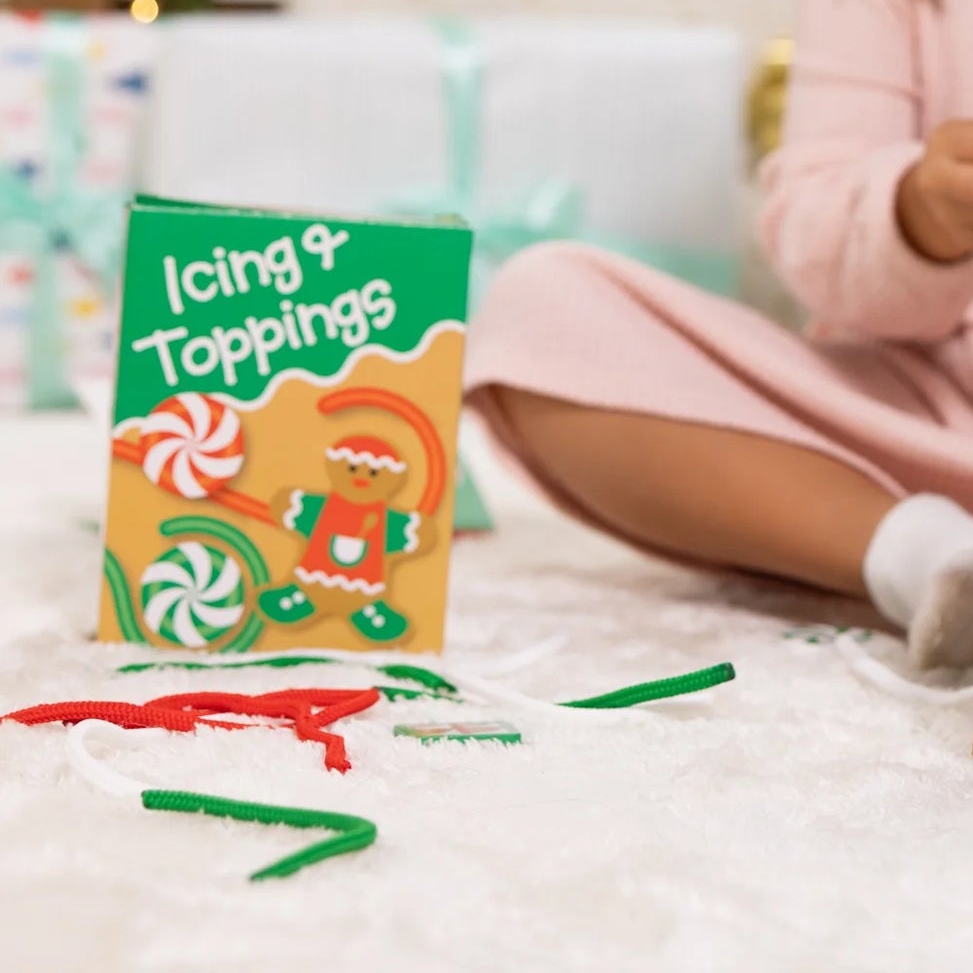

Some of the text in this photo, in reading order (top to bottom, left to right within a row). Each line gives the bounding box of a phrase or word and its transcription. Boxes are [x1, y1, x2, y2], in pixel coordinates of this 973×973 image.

[163, 223, 350, 315] Icing &
[131, 278, 396, 387] Toppings
